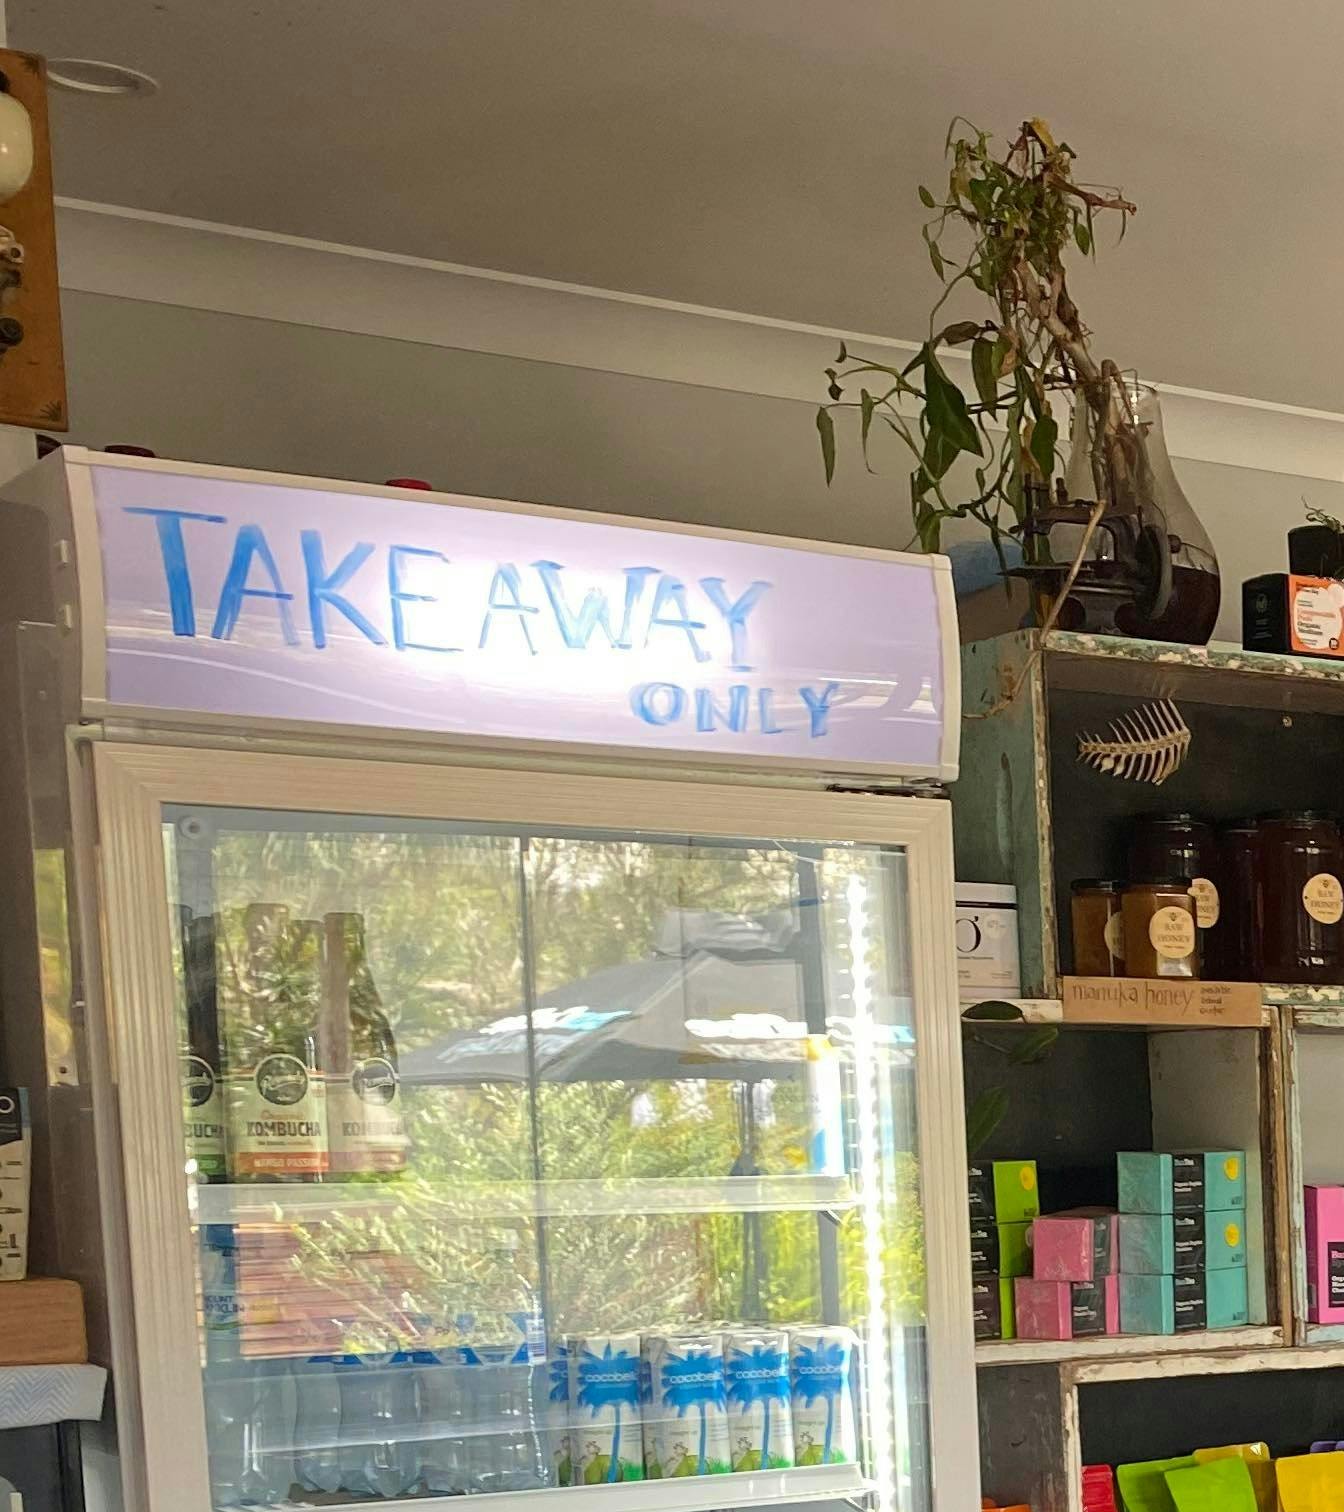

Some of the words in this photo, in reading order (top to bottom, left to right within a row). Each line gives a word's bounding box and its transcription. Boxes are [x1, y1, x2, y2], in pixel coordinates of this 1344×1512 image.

[628, 681, 839, 739] ONLY
[1072, 981, 1138, 1008] manuka
[1145, 981, 1194, 1016] honey
[246, 1120, 322, 1138] KOMBUCHA
